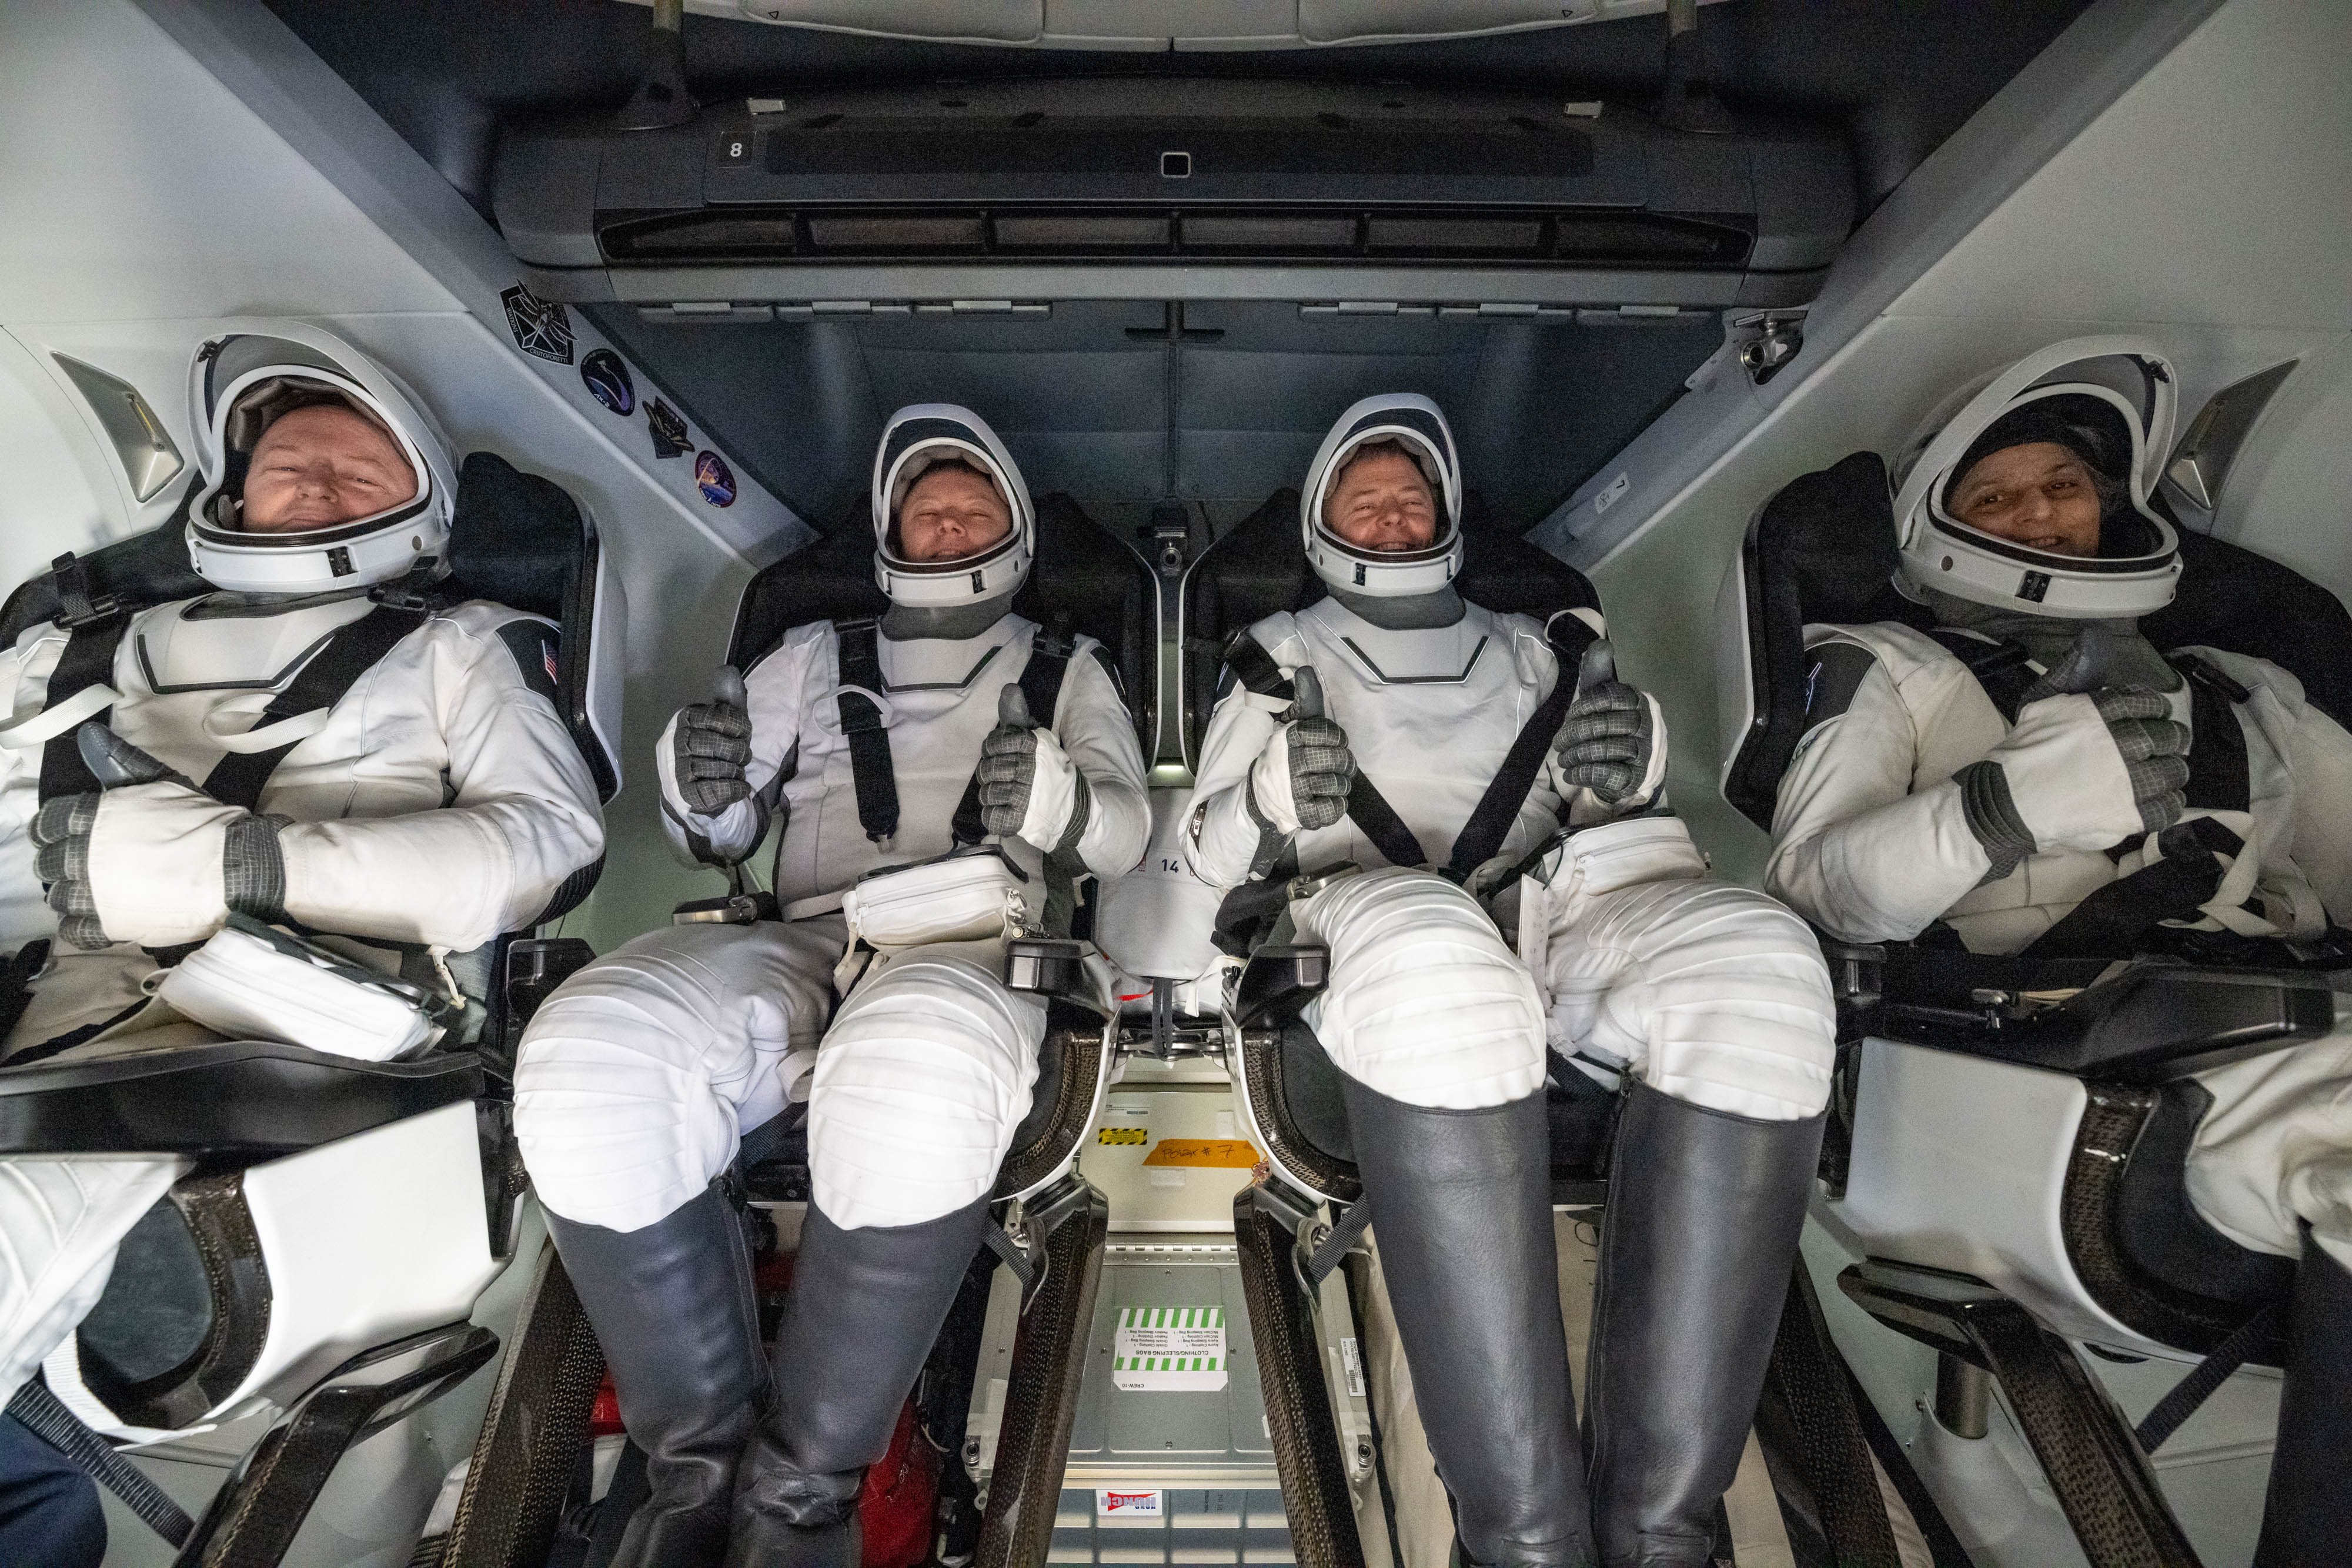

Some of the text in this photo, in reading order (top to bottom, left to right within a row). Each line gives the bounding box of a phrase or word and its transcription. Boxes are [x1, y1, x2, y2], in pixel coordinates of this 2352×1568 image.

[730, 142, 742, 157] 8
[506, 307, 519, 332] WATKINS
[529, 348, 568, 363] CRISTOFORETTI
[1161, 859, 1179, 873] 14
[1217, 1144, 1234, 1158] 7
[1101, 1497, 1156, 1506] HUNCH
